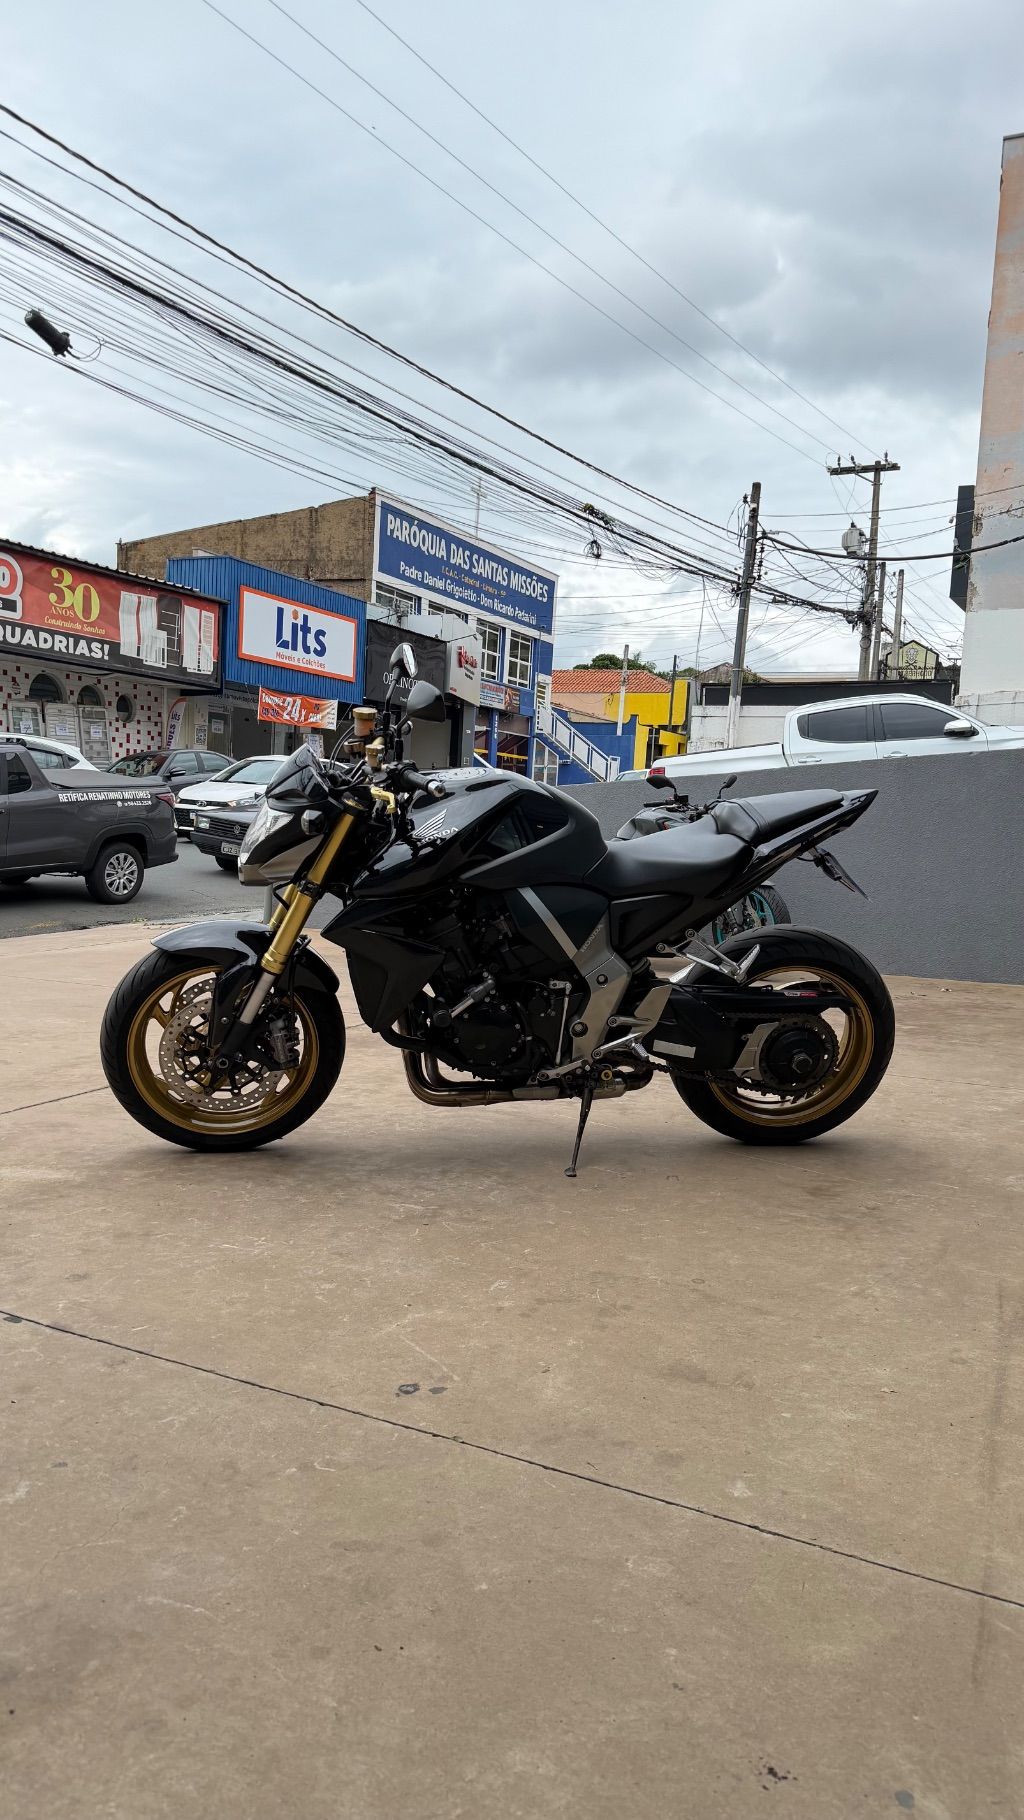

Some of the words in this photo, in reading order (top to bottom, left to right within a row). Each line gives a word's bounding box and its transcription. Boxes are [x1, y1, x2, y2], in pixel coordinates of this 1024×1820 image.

[387, 513, 447, 560] PARÓQUIA
[450, 543, 470, 571] DAS
[472, 553, 508, 586] SANTAS
[510, 571, 548, 602] MISSÕES
[49, 567, 100, 622] 30
[400, 561, 422, 582] Padre
[423, 570, 445, 591] Daniel
[480, 593, 494, 608] Dom
[494, 598, 514, 617] Ricardo
[45, 616, 81, 630] Construindo
[83, 623, 106, 635] Sonhos
[50, 606, 75, 617] ANOS
[0, 624, 110, 660] UADRIAS!
[276, 606, 327, 658] Lits
[275, 651, 296, 663] Móveis
[301, 656, 326, 670] Colchões
[58, 791, 88, 802] RETÍFICA
[88, 791, 122, 801] RENATINHO
[122, 790, 151, 800] MOTORES
[420, 827, 459, 844] HONDA
[580, 924, 604, 953] HONDA
